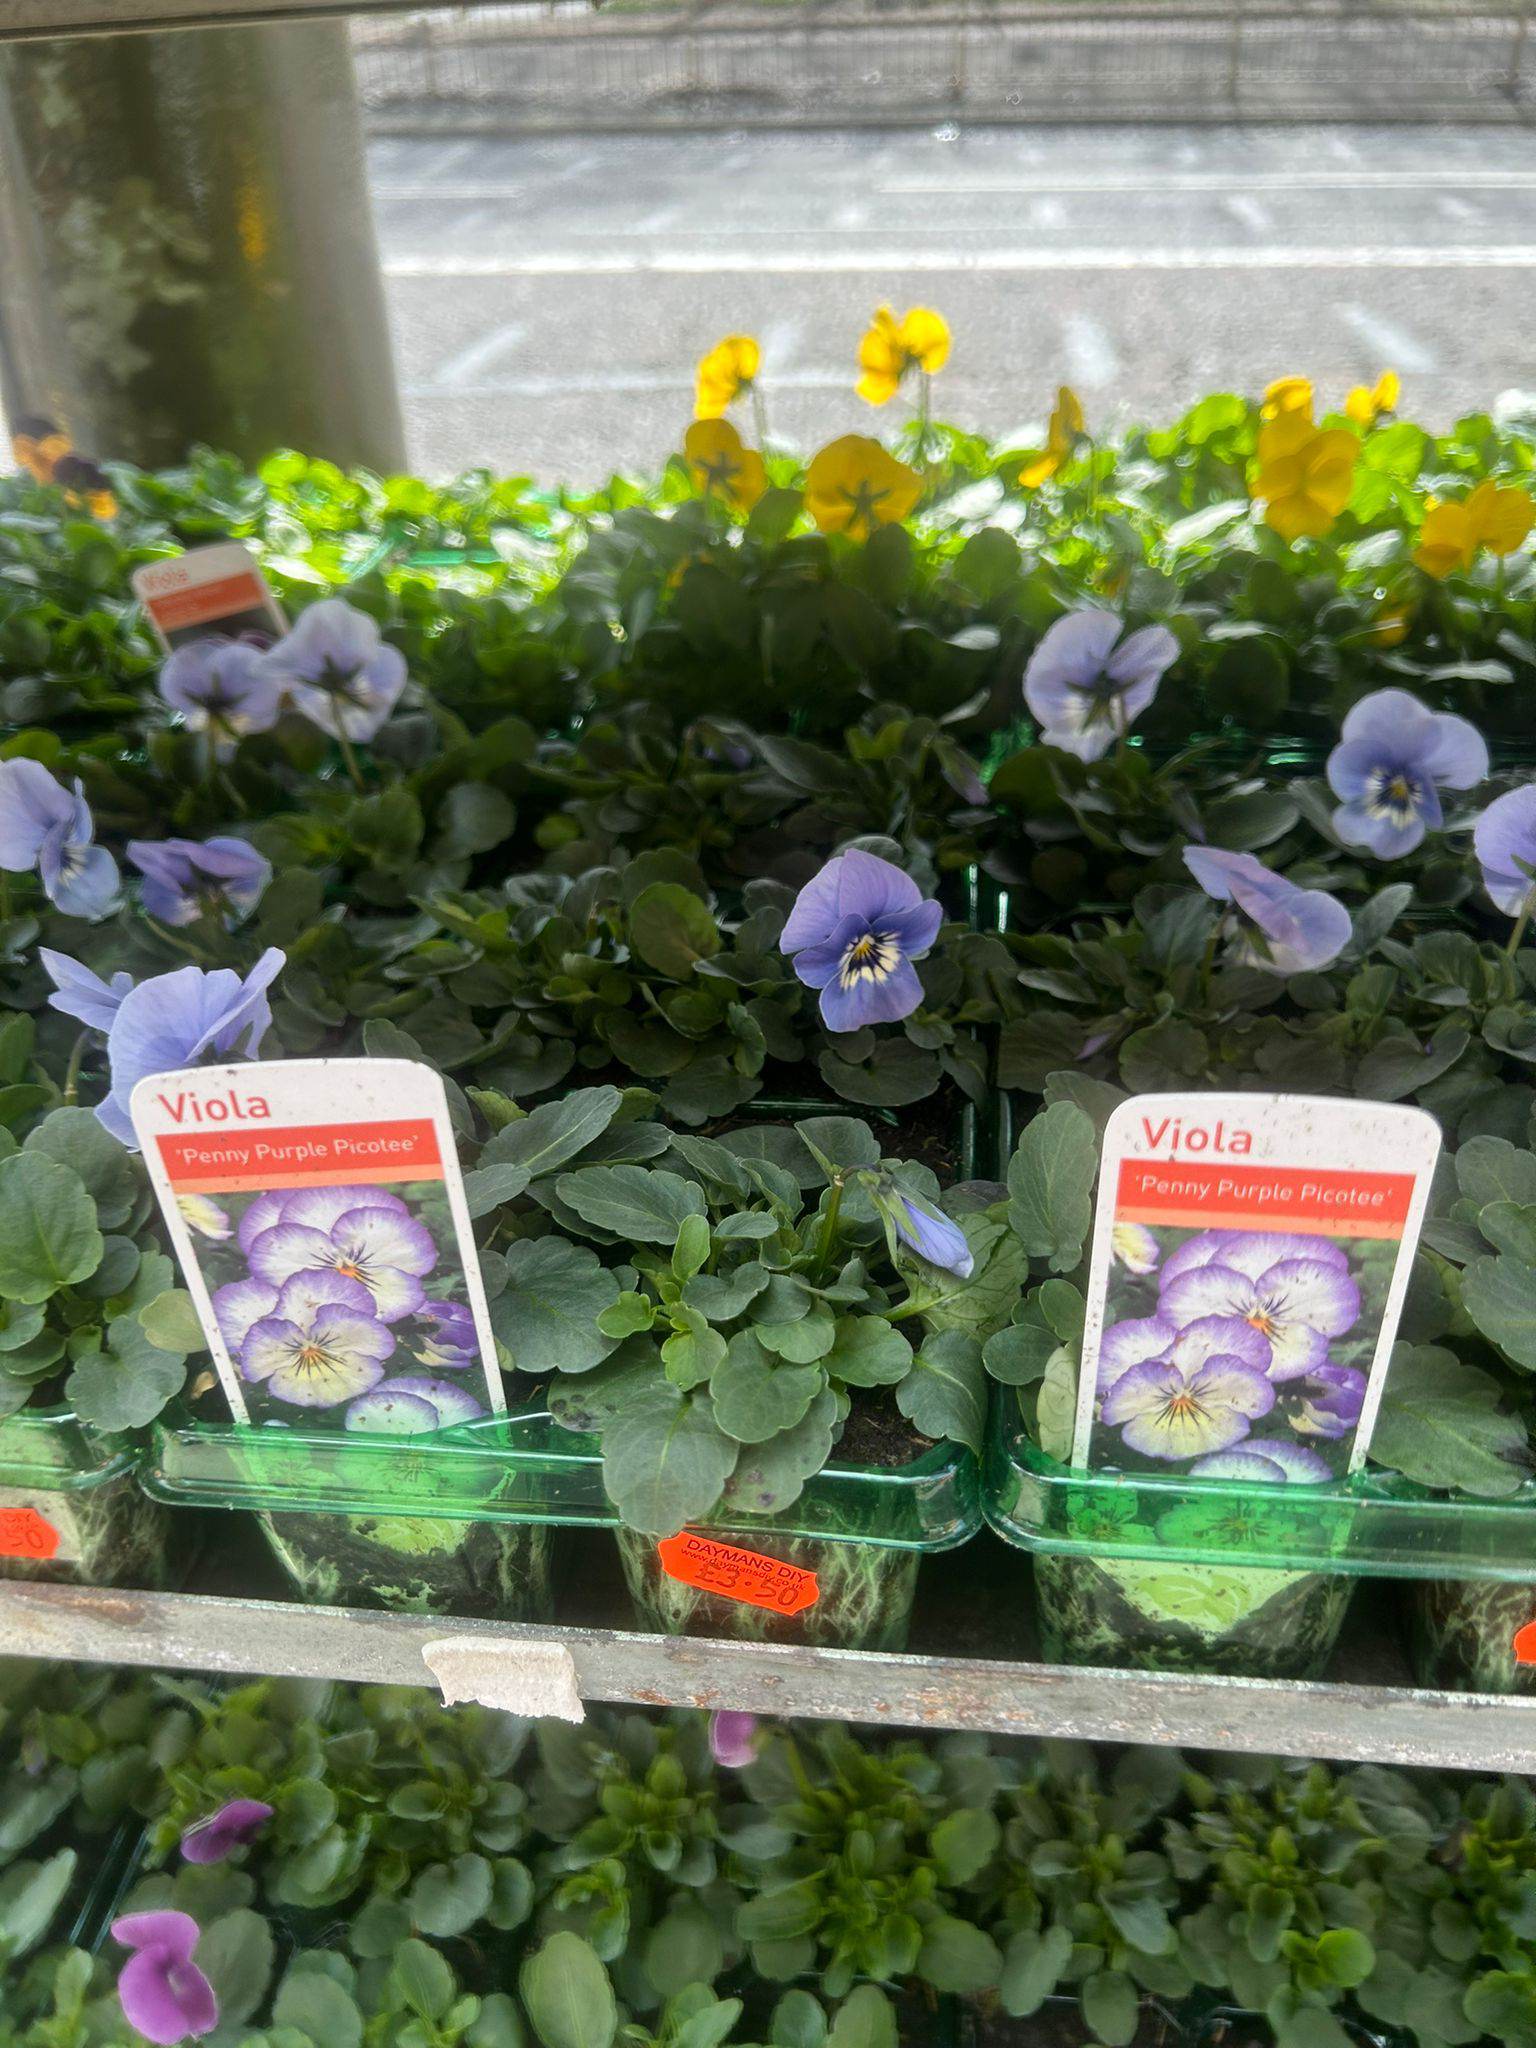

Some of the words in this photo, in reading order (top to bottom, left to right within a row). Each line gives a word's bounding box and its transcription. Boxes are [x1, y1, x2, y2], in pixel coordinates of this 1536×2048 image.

[157, 1090, 271, 1123] Viola
[256, 1142, 328, 1162] Purple
[1142, 1117, 1251, 1154] Viola
[1217, 1181, 1293, 1203] Purple
[686, 1539, 775, 1573] DAYMANS
[777, 1566, 809, 1583] DIY
